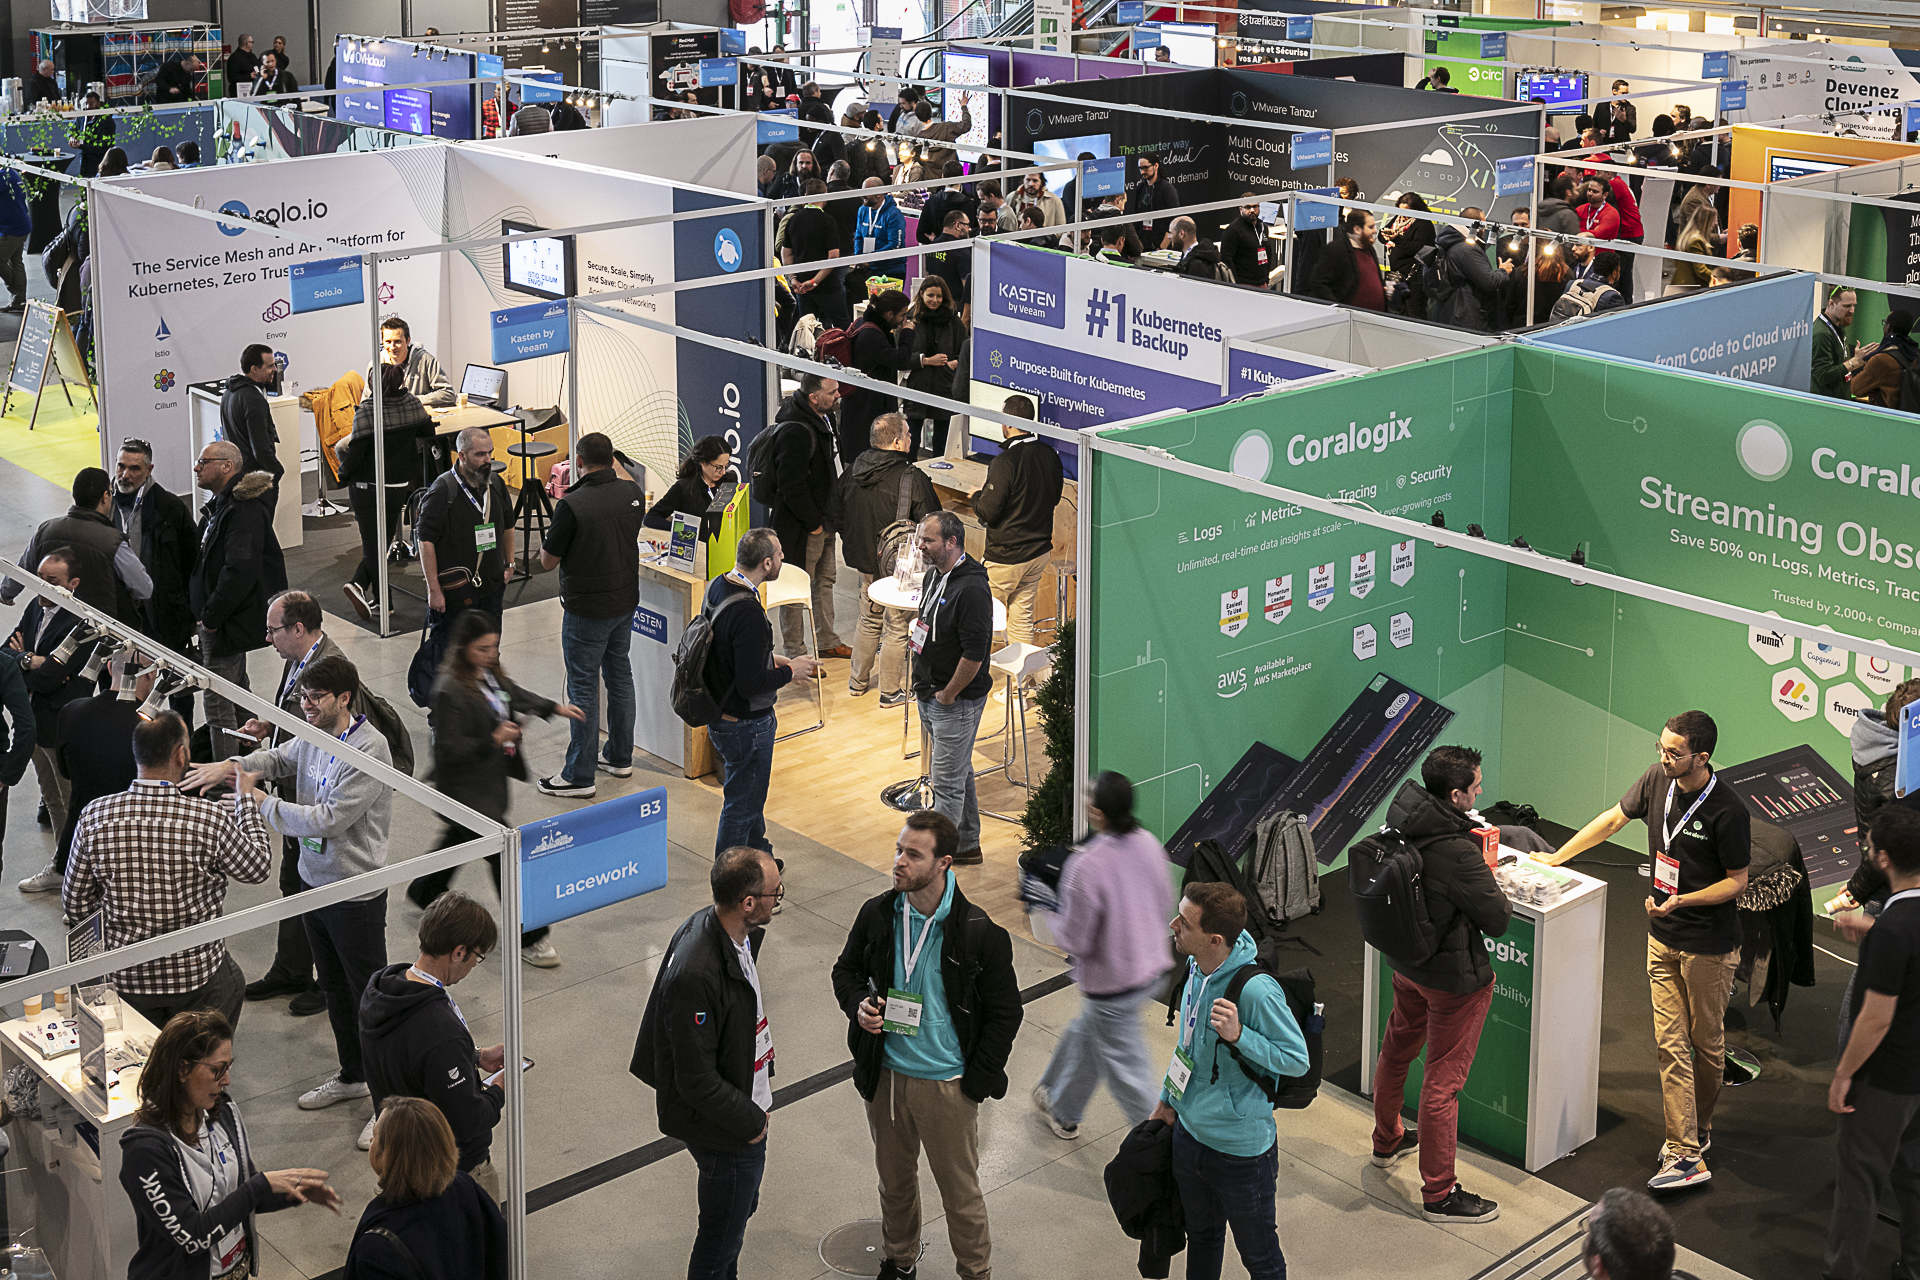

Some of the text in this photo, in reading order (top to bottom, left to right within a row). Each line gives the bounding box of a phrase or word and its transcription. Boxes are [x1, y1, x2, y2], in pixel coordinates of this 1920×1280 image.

[1276, 46, 1308, 57] Sécurise
[1826, 78, 1899, 99] Devenez
[1252, 101, 1314, 118] VMware Tanzu
[1825, 97, 1872, 114] Cloud
[1048, 110, 1108, 125] VMware Tanzu
[1119, 139, 1190, 155] The smarter way
[1228, 135, 1253, 149] Multi
[1255, 139, 1285, 153] Cloud
[1228, 152, 1270, 168] At Scale
[1297, 152, 1315, 160] VMware
[1177, 170, 1209, 184] demand
[1228, 170, 1248, 182] Your
[1250, 174, 1280, 187] golden
[1282, 178, 1301, 190] path
[1519, 180, 1531, 188] Labs
[1309, 215, 1325, 223] JFrog
[132, 230, 406, 276] The Service Mesh and for
[293, 267, 305, 276] C3
[587, 261, 654, 284] Secure, Scale, Simplify
[128, 267, 290, 298] Kubernetes, Zero Trus
[587, 274, 599, 283] and
[600, 276, 617, 288] Save:
[314, 286, 343, 299] Solo.io
[998, 282, 1056, 308] KASTEN
[1008, 302, 1046, 318] by Veeam
[1085, 288, 1126, 344] #1
[496, 314, 509, 324] C4
[1132, 307, 1222, 342] Kubernetes
[266, 330, 287, 340] Envoy
[510, 328, 554, 345] Kasten by
[1690, 344, 1724, 365] Code
[1727, 340, 1740, 355] to
[1742, 330, 1780, 352] Cloud
[1782, 320, 1808, 341] with
[517, 341, 548, 354] Veeam
[1132, 329, 1188, 360] Backup
[154, 350, 170, 358] Istio
[1240, 367, 1252, 380] #1
[1730, 355, 1778, 382] CNAPP
[1010, 356, 1146, 400] Purpose-Built for Kubernetes
[154, 401, 177, 411] Cilium
[1048, 392, 1104, 417] Everywhere
[1286, 411, 1413, 466] Coralogix
[1193, 464, 1452, 542] Logs Metrics Tracing Security
[1640, 476, 1823, 554] Streaming
[1177, 492, 1452, 574] Unlimited, real-time data insights at scale ever-growing costs
[1393, 562, 1405, 571] Love
[1396, 555, 1410, 564] Users
[1670, 528, 1705, 548] Save
[1710, 538, 1743, 558] 50%
[1749, 550, 1766, 564] on
[1772, 553, 1812, 576] Logs,
[1818, 564, 1880, 593] Metrics,
[1314, 575, 1329, 584] Easiest
[1355, 570, 1371, 578] Support
[1268, 588, 1290, 597] Momentum
[1315, 582, 1327, 590] Setup
[1226, 600, 1242, 609] Easiest
[1271, 595, 1285, 603] Leader
[1772, 589, 1814, 609] Trusted
[1817, 600, 1830, 615] by
[1834, 605, 1873, 624] 2,000+
[633, 609, 662, 630] ASTEN
[1393, 627, 1410, 636] PARTNER
[1756, 634, 1780, 648] PUMA
[1254, 655, 1294, 674] Available in
[1807, 652, 1841, 667] Capgemini
[1217, 668, 1247, 688] aws
[1254, 662, 1312, 686] AWS Marketplace
[640, 799, 661, 818] B3
[556, 861, 639, 899] Lacework
[139, 1168, 226, 1254] LACEWORK
